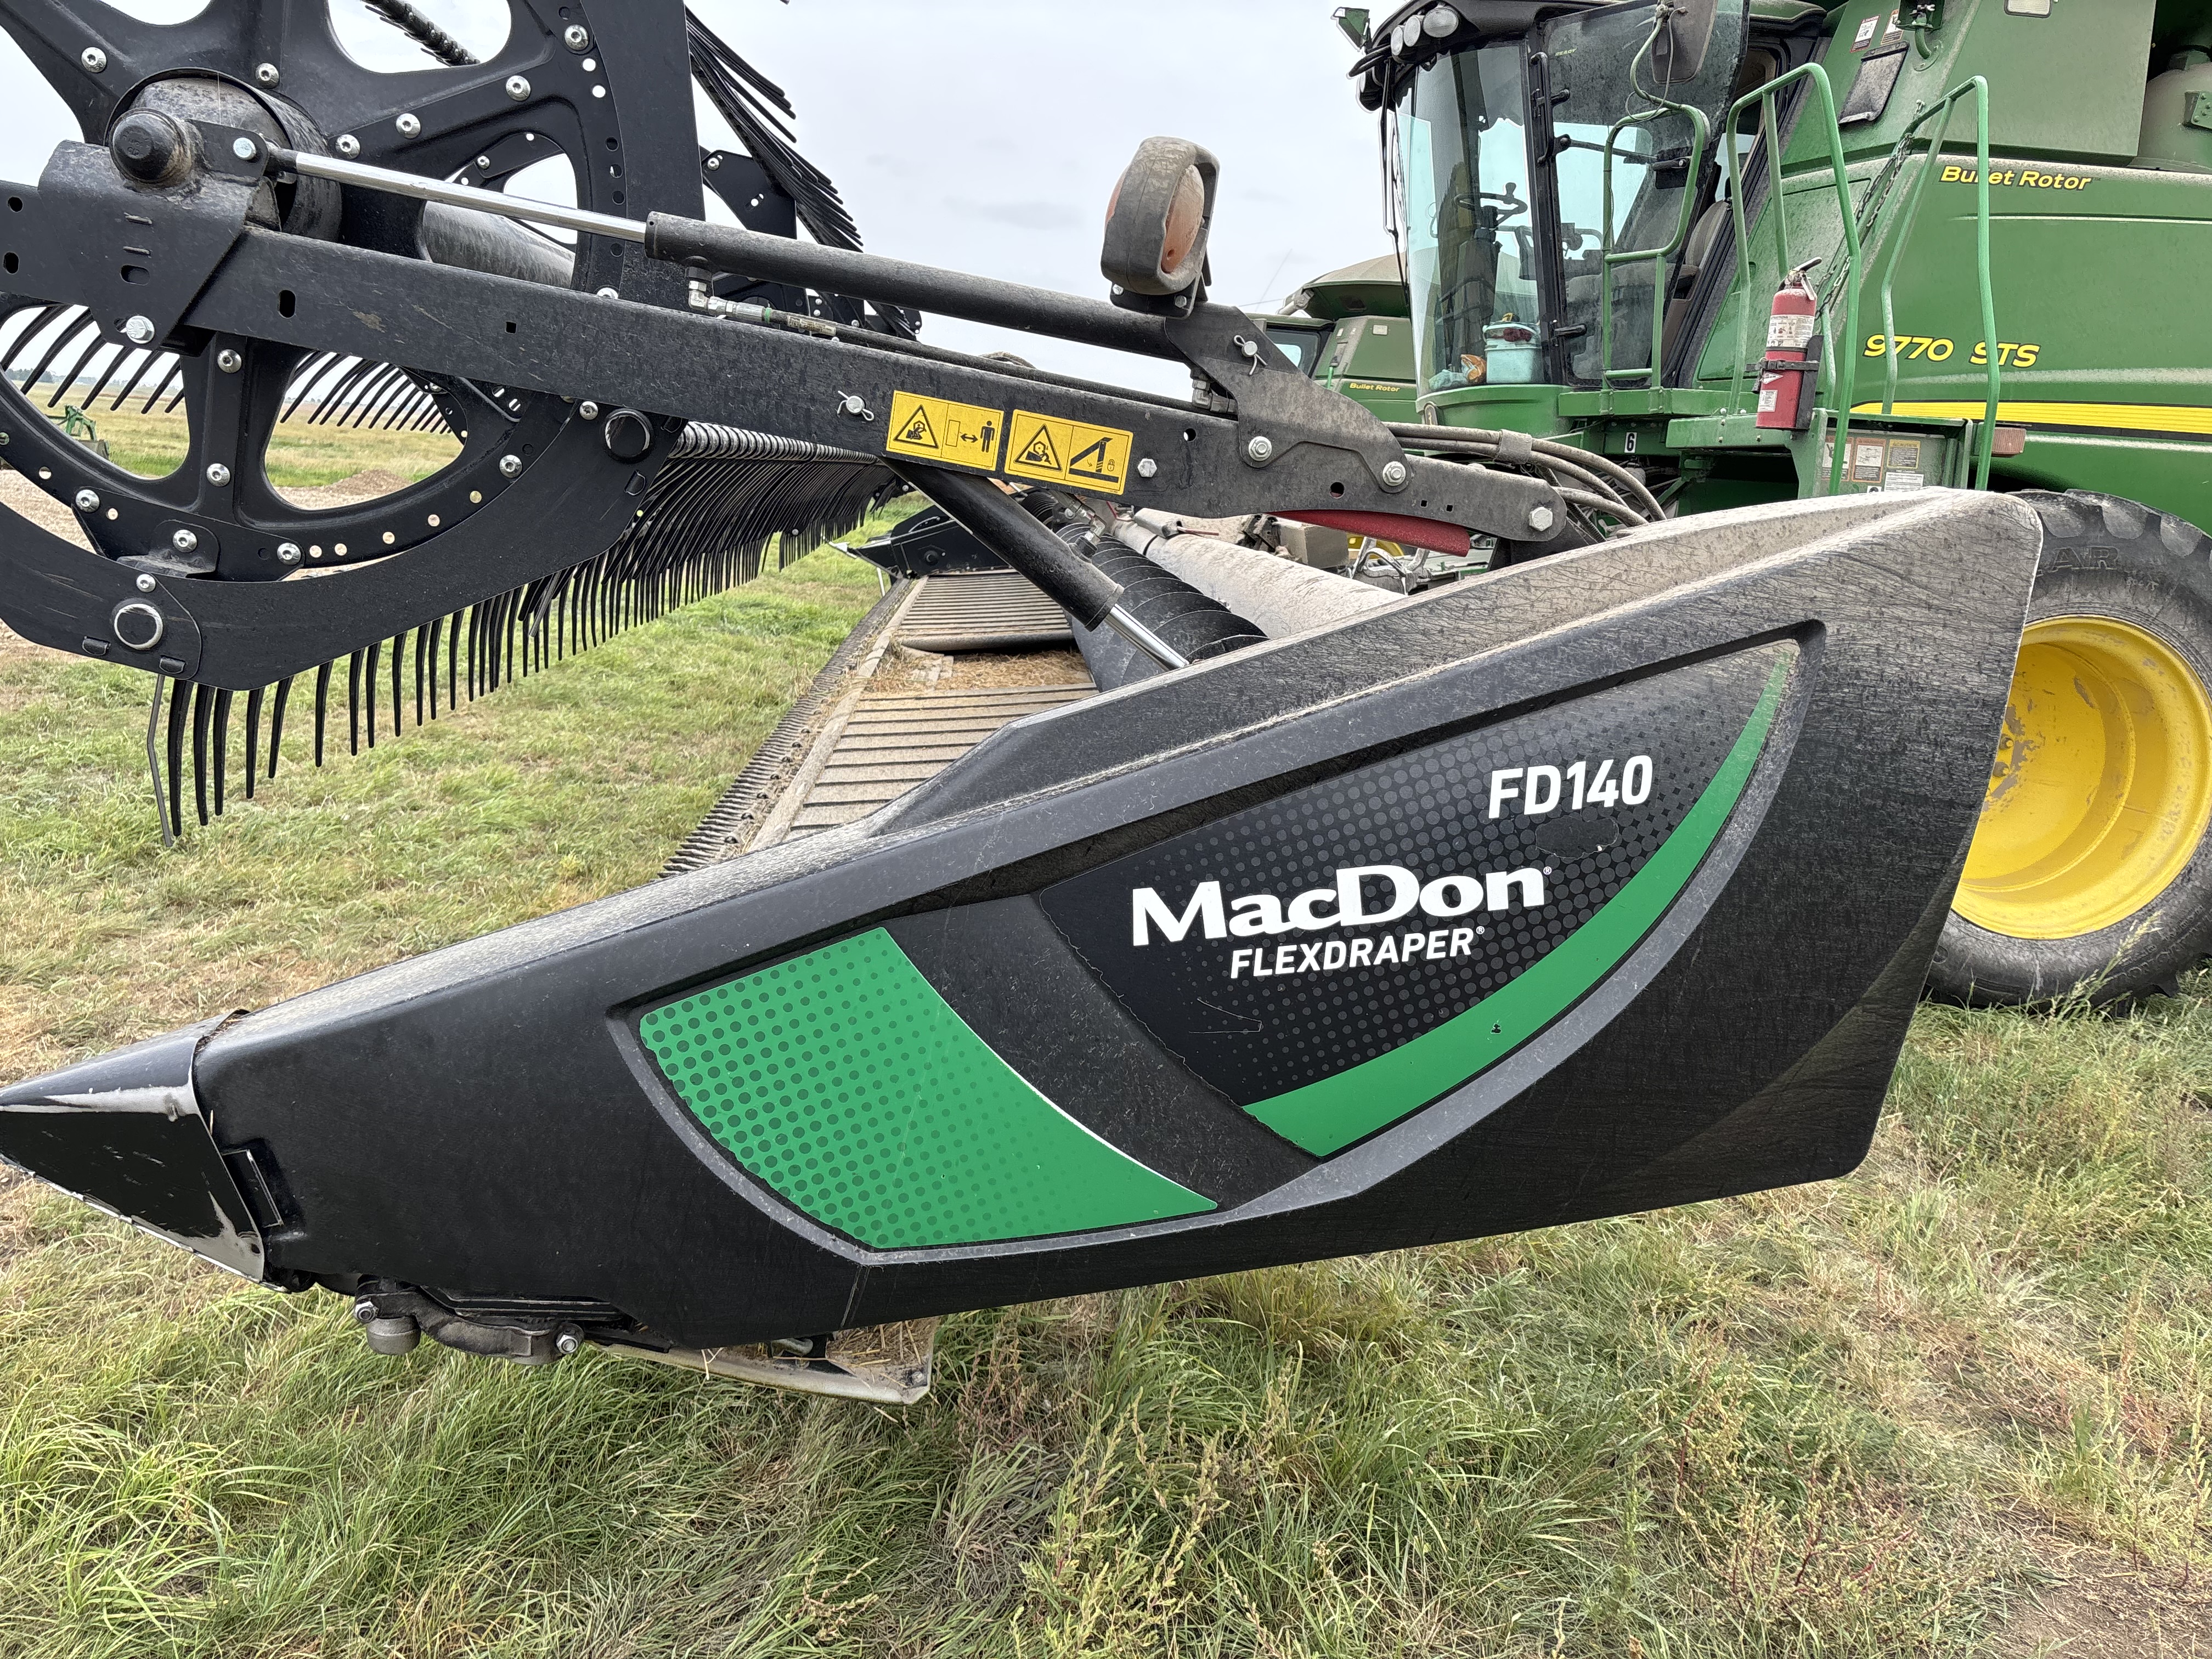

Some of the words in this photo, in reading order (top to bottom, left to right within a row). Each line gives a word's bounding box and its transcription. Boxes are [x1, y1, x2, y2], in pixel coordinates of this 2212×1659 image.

[1940, 166, 2015, 185] Buet
[2019, 171, 2092, 190] Rotor
[1864, 334, 1954, 362] 9770
[1970, 342, 2040, 368] STS
[1627, 433, 1635, 452] 6
[1488, 755, 1653, 819] FD140
